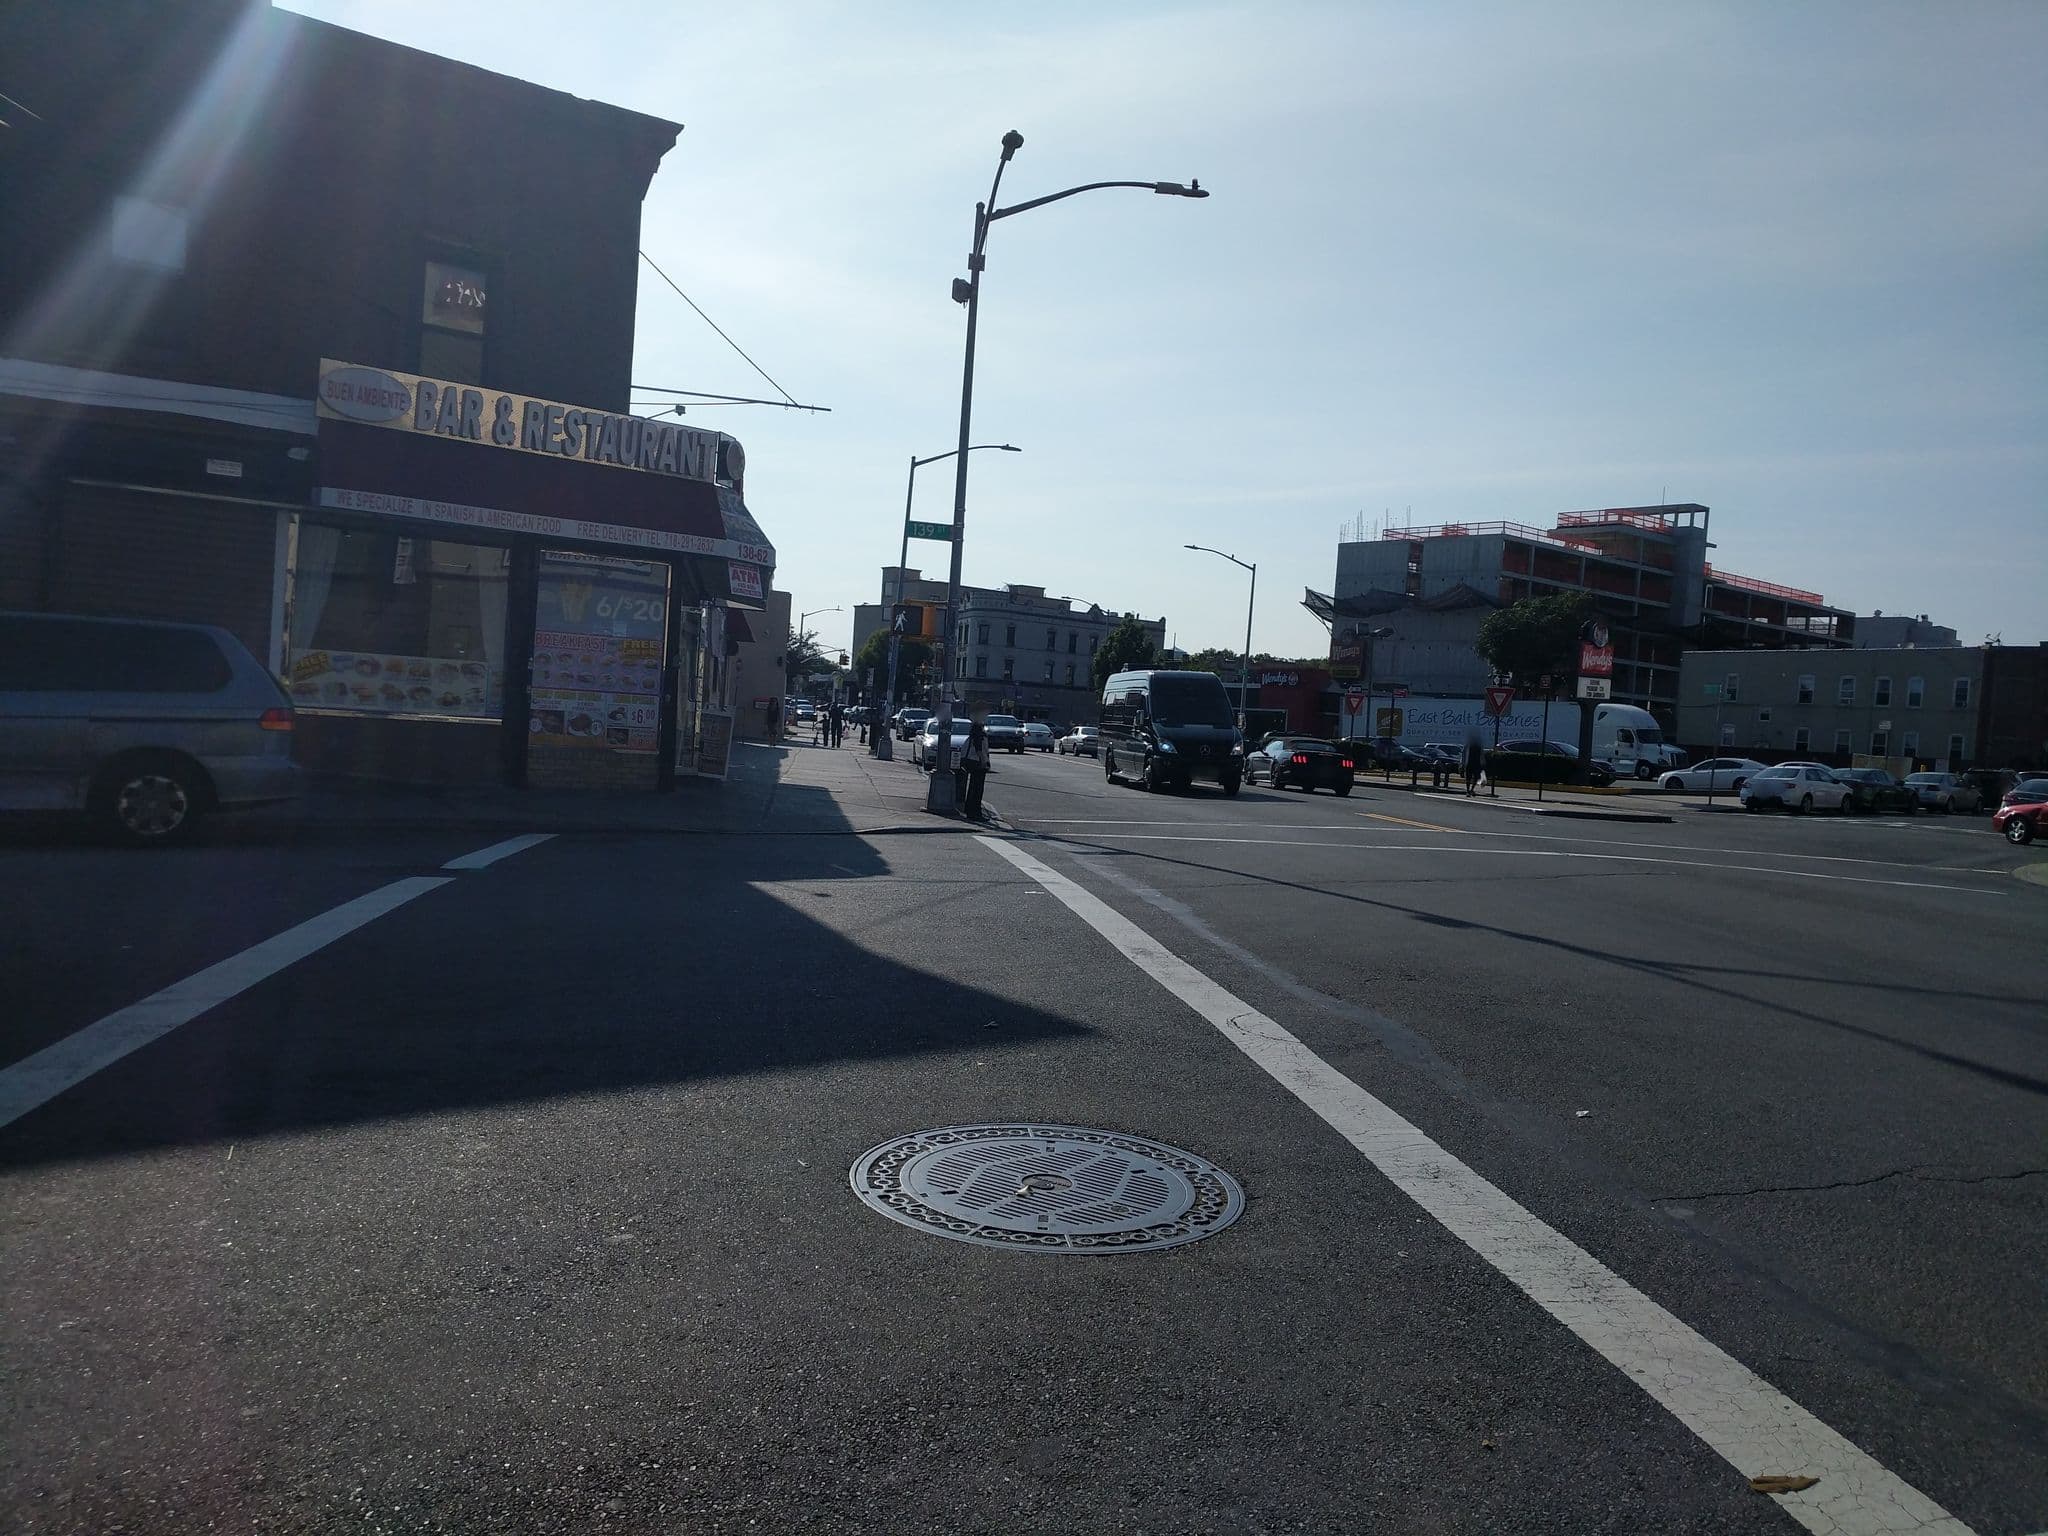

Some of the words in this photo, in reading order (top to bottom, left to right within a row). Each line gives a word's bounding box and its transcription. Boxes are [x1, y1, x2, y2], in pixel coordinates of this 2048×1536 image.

[327, 380, 354, 400] BUEN
[357, 385, 406, 411] AMBIENTE
[414, 381, 483, 440] BAR
[492, 396, 515, 446] &
[521, 401, 715, 479] RESTAURANT
[355, 492, 413, 514] SPECIALIZE
[423, 500, 431, 515] IN
[434, 503, 474, 522] SPANISH
[487, 510, 533, 530] AMERICAN
[536, 518, 561, 534] FOOD
[577, 522, 600, 538] FREE
[602, 526, 643, 545] DELIVERY
[646, 533, 661, 546] TEL
[912, 523, 935, 537] 139
[732, 568, 760, 585] ATM
[535, 631, 608, 651] BREAKFAST
[624, 640, 658, 649] FREE
[1582, 649, 1613, 671] Wendy's
[1407, 708, 1438, 724] East
